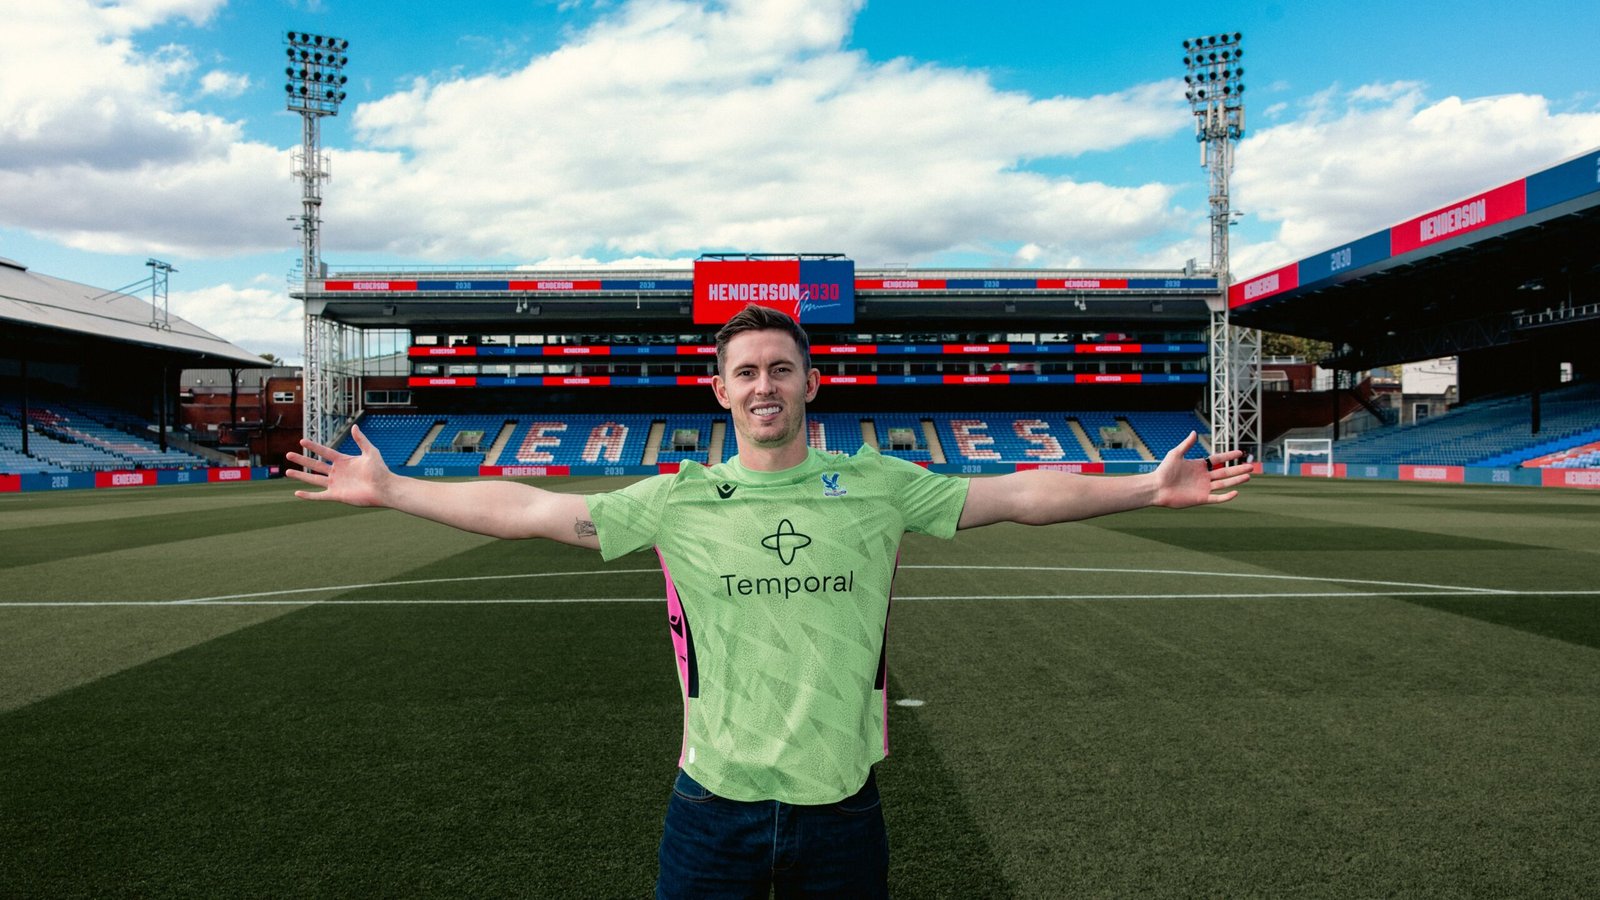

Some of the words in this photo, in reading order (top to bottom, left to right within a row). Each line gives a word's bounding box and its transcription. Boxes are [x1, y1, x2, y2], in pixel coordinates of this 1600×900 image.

[1420, 198, 1486, 242] HENDERSON
[709, 283, 799, 301] HENDERSON
[800, 283, 839, 301] 2030
[424, 467, 444, 476] 2030
[502, 466, 547, 476] HENDERSON
[605, 467, 625, 476] 2030
[962, 465, 982, 473] 2030
[720, 570, 853, 599] Temporal
